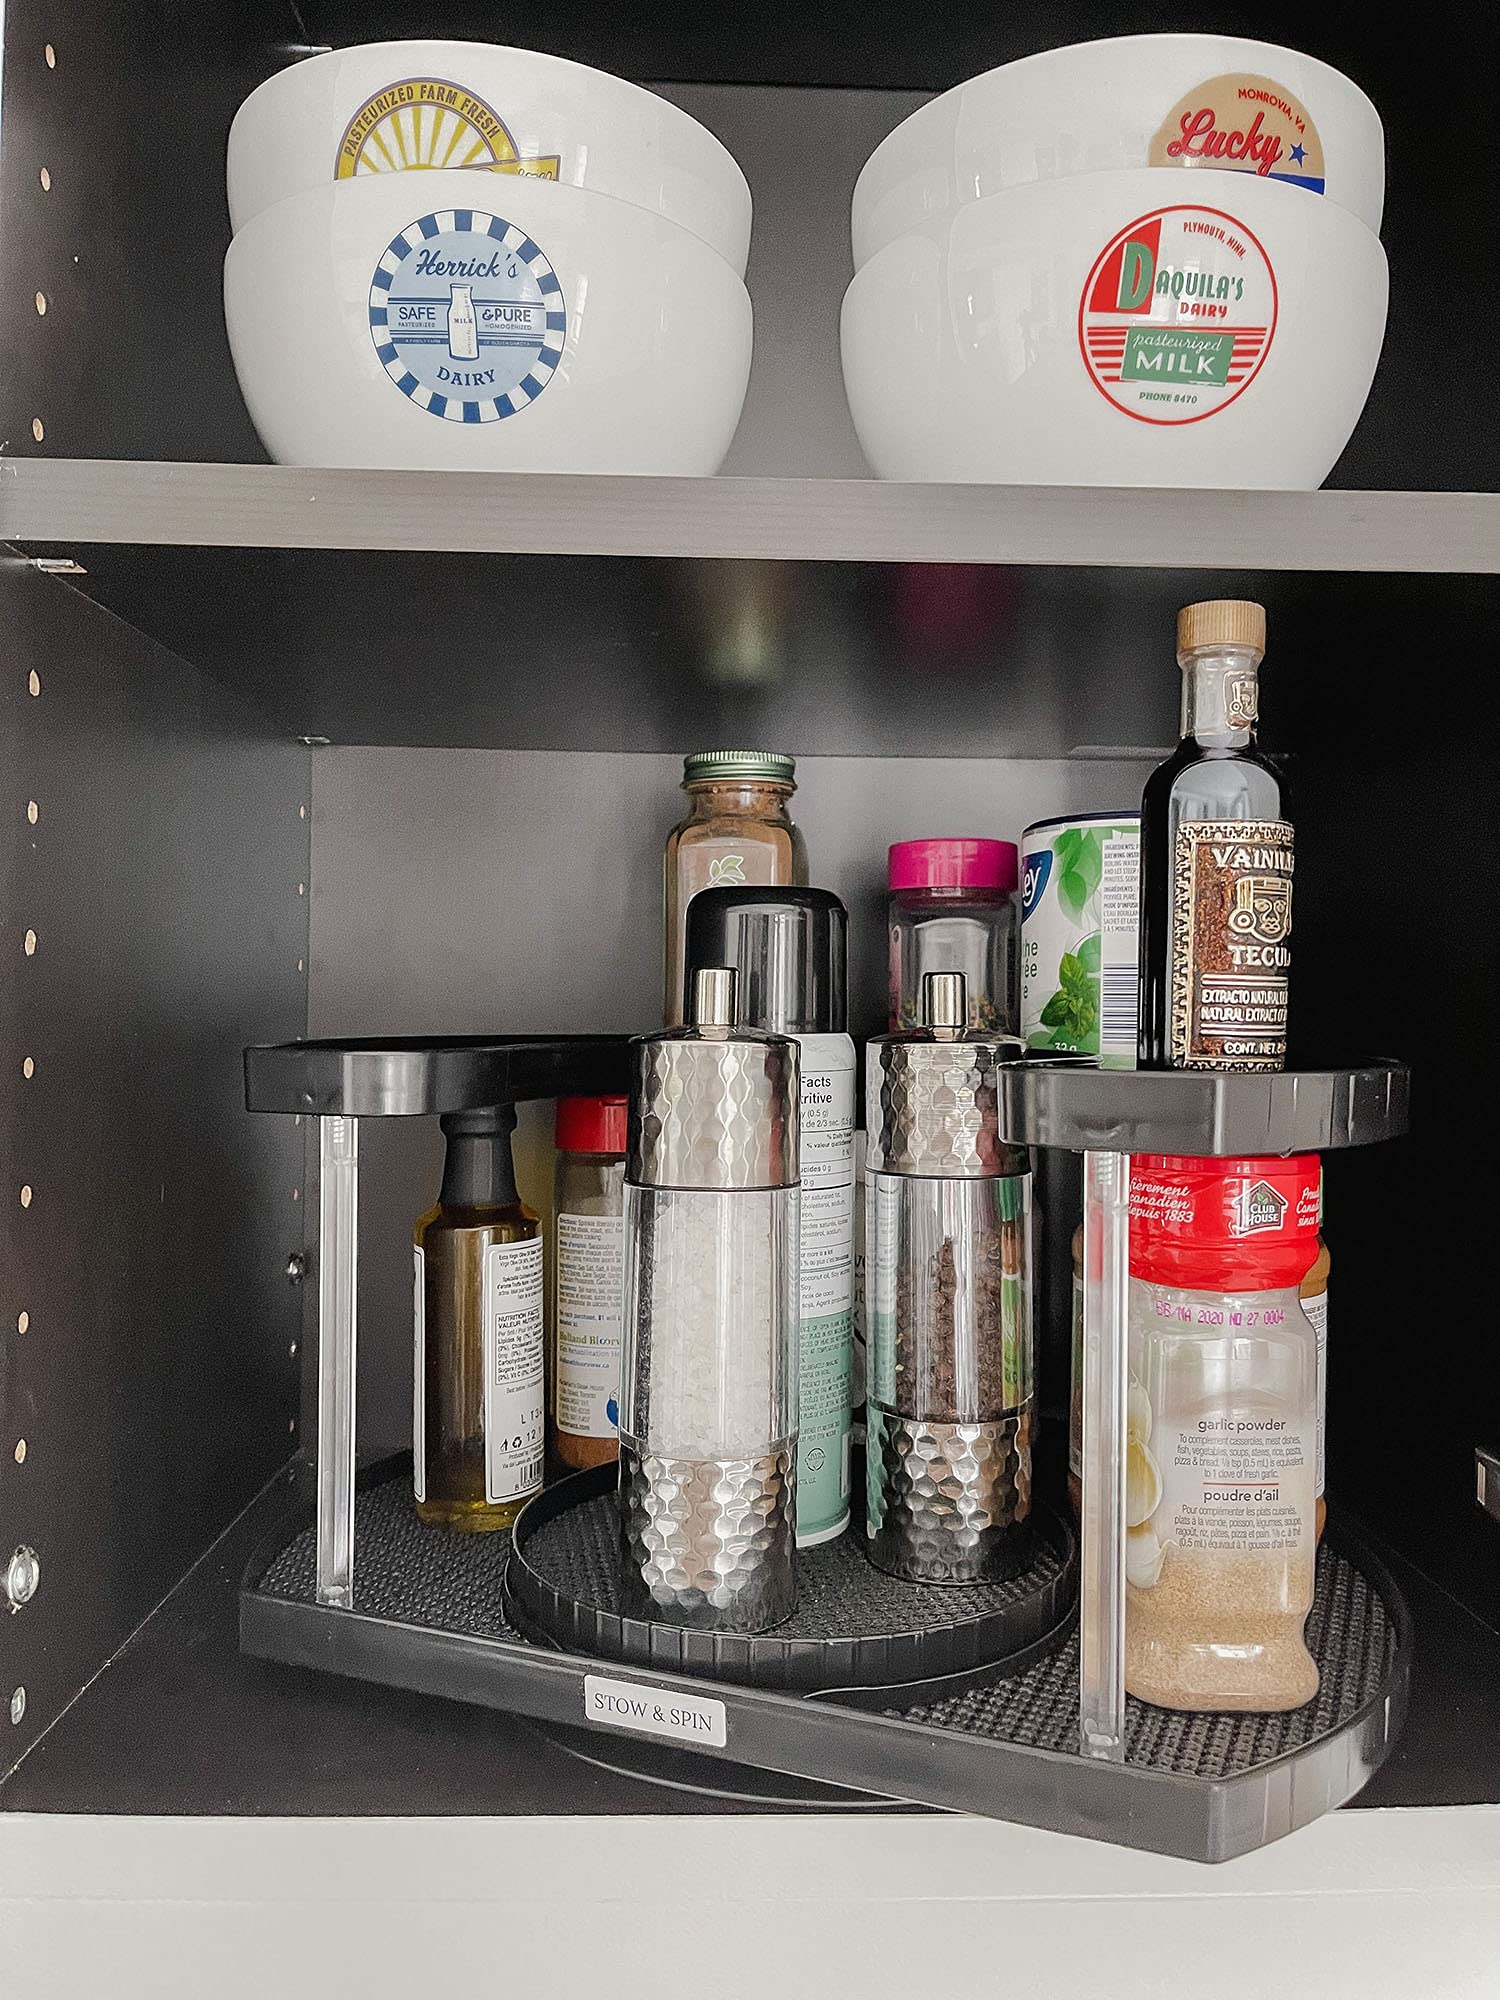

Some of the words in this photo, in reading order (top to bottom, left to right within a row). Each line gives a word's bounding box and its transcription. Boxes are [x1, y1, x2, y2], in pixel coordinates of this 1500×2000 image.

[1238, 88, 1293, 120] MONROVIA,
[1295, 119, 1306, 134] VA
[343, 88, 414, 157] PASTEURIZED
[420, 84, 458, 105] FARM
[461, 97, 500, 139] FRESH
[1167, 108, 1283, 176] Lucky
[415, 249, 519, 278] Herrick's
[399, 307, 436, 320] SAFE
[1180, 302, 1228, 318] DAIRY
[1133, 332, 1223, 355] pasteurized
[1136, 351, 1215, 375] MILK
[436, 366, 495, 386] DAIRY
[1139, 391, 1172, 402] PHONE
[1202, 989, 1250, 1004] EXTRACTO
[1201, 1007, 1244, 1021] NATURAL
[816, 1119, 828, 1127] 2/3
[1130, 1177, 1190, 1196] fièrement
[1250, 1203, 1275, 1214] CLUB
[1165, 1209, 1194, 1223] 1883
[1249, 1212, 1278, 1225] HOUSE
[498, 1313, 526, 1322] NUTRITION
[498, 1320, 520, 1328] VALEUR
[1198, 1309, 1223, 1324] 2020
[1247, 1312, 1259, 1325] 27
[1198, 1419, 1235, 1432] garlic
[1237, 1419, 1286, 1433] powder
[1180, 1434, 1187, 1443] To
[1189, 1436, 1228, 1446] complement
[1174, 1457, 1191, 1466] pizza
[1204, 1469, 1211, 1477] to
[1203, 1489, 1252, 1503] poudre
[1254, 1489, 1279, 1501] d'ail
[1182, 1504, 1198, 1513] Pour
[594, 1692, 648, 1717] STOW
[652, 1705, 666, 1722] &
[670, 1708, 713, 1732] SPIN
